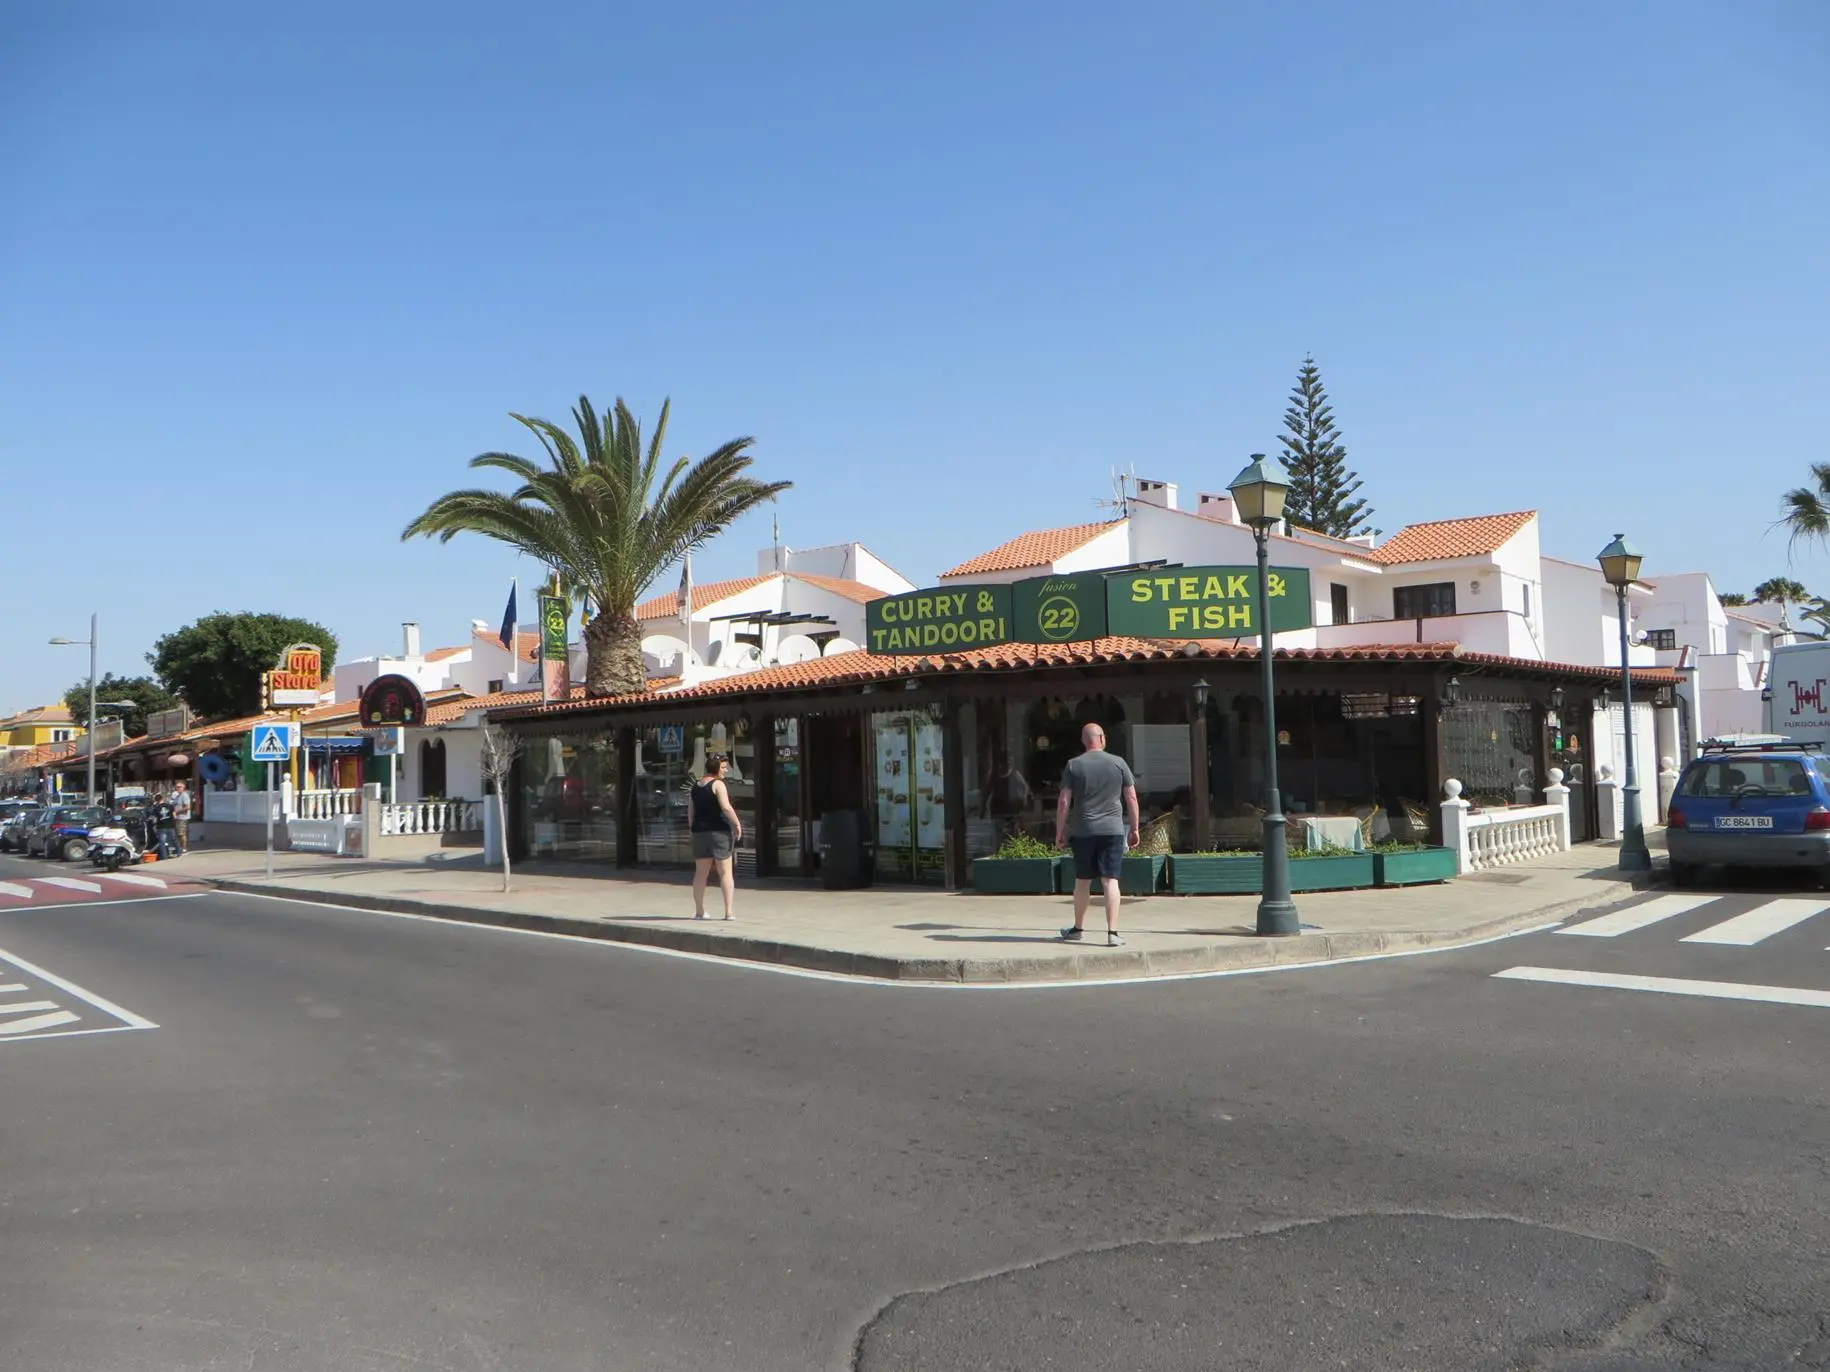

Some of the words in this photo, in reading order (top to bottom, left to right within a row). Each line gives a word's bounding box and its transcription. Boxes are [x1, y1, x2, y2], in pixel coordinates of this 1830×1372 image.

[1038, 580, 1077, 597] fusion
[1131, 575, 1251, 602] STEAK
[1267, 573, 1286, 597] &
[881, 592, 968, 623] CURRY
[976, 590, 994, 613] &
[1044, 607, 1076, 629] 22
[1168, 605, 1251, 631] FISH
[872, 617, 1006, 651] TANDOORI
[274, 672, 320, 688] Store
